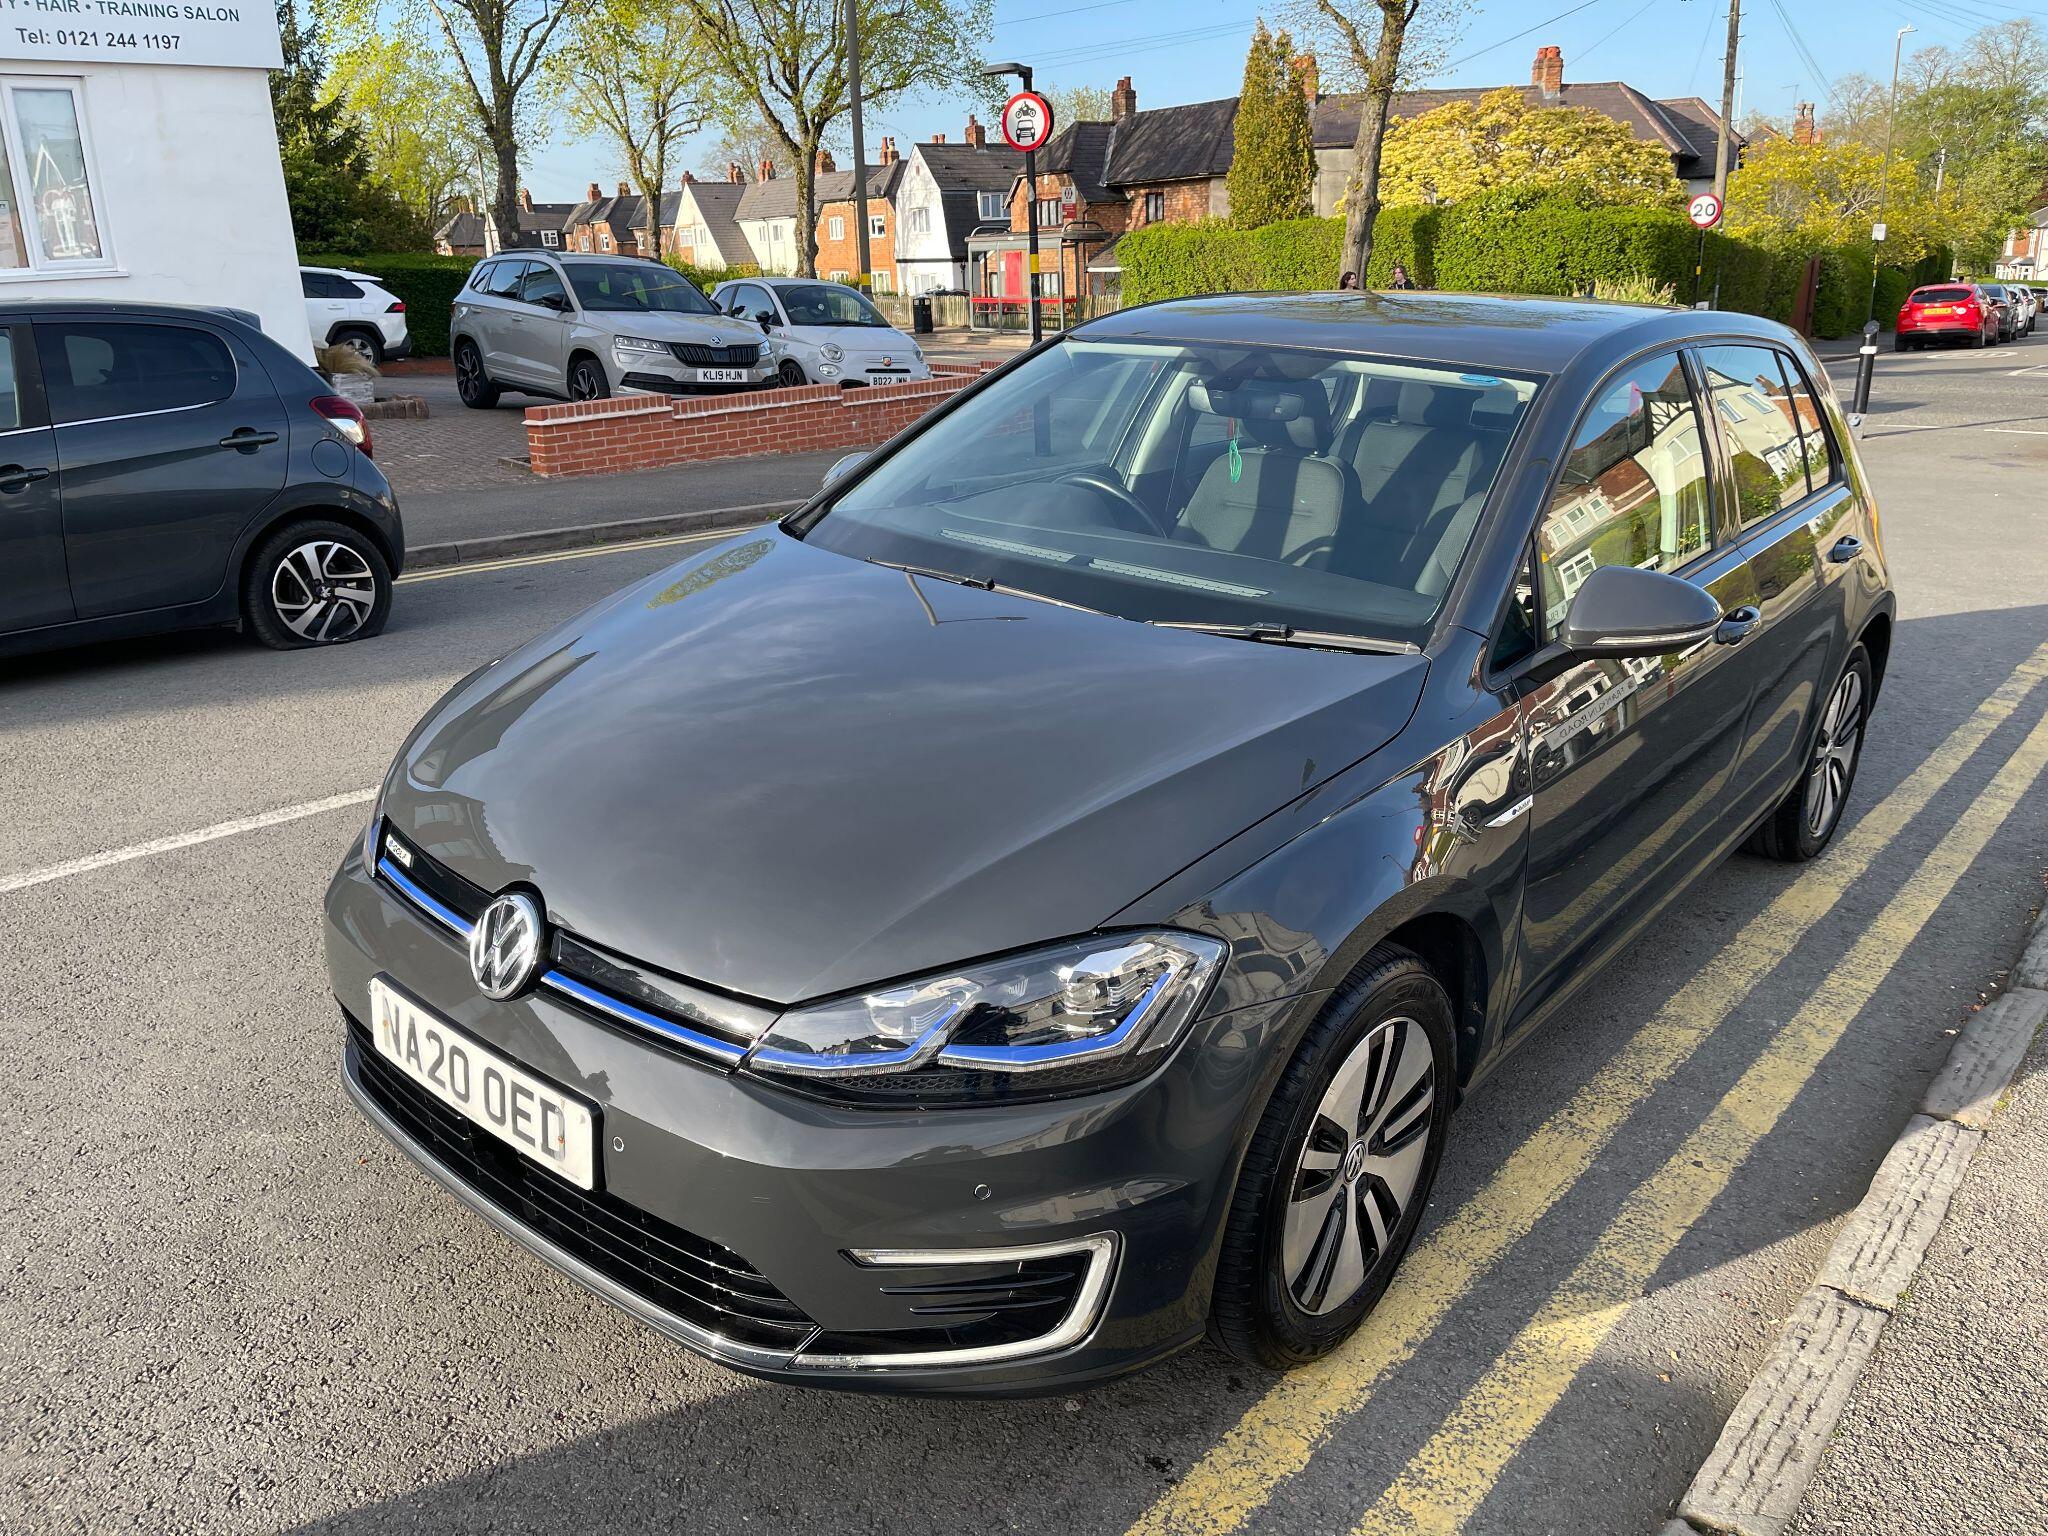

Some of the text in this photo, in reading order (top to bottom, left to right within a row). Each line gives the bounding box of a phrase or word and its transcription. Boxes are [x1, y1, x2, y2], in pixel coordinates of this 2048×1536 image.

[36, 0, 81, 13] HAIR
[95, 0, 179, 19] TRAINING
[183, 6, 240, 22] SALON
[15, 27, 181, 50] Tel: 0121 244 1197
[1693, 203, 1716, 217] 20
[702, 370, 743, 381] KL19 HJN
[382, 994, 567, 1163] NA20 OED
